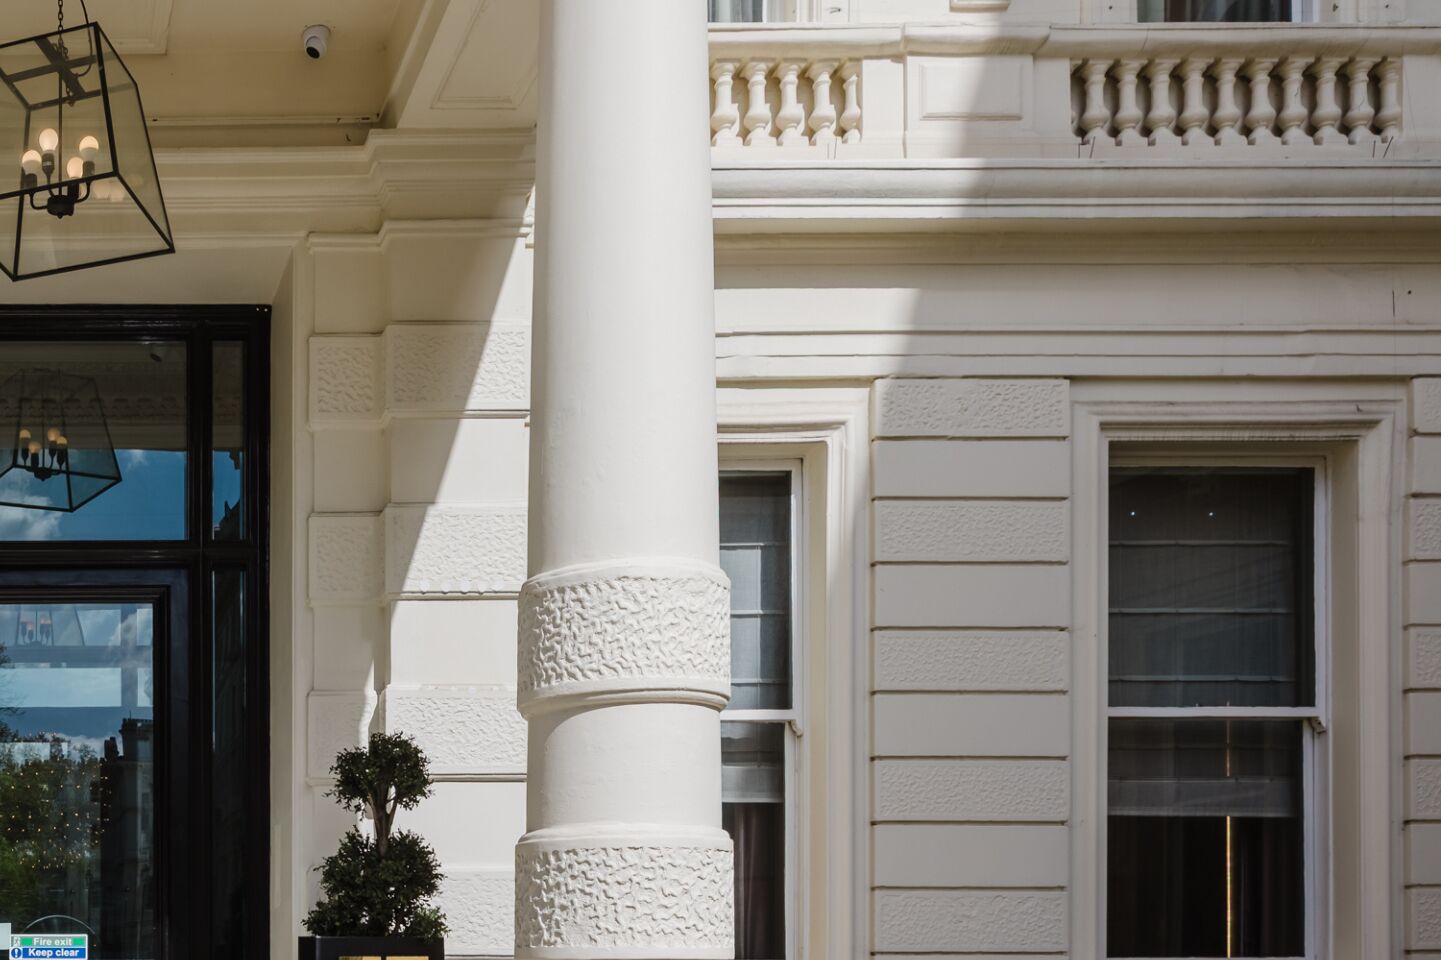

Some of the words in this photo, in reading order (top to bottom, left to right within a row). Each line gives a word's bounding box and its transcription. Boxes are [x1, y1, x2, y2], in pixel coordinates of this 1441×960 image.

[33, 937, 53, 946] Fire
[54, 937, 72, 946] exit
[28, 948, 53, 958] Keep
[55, 948, 80, 957] clear
